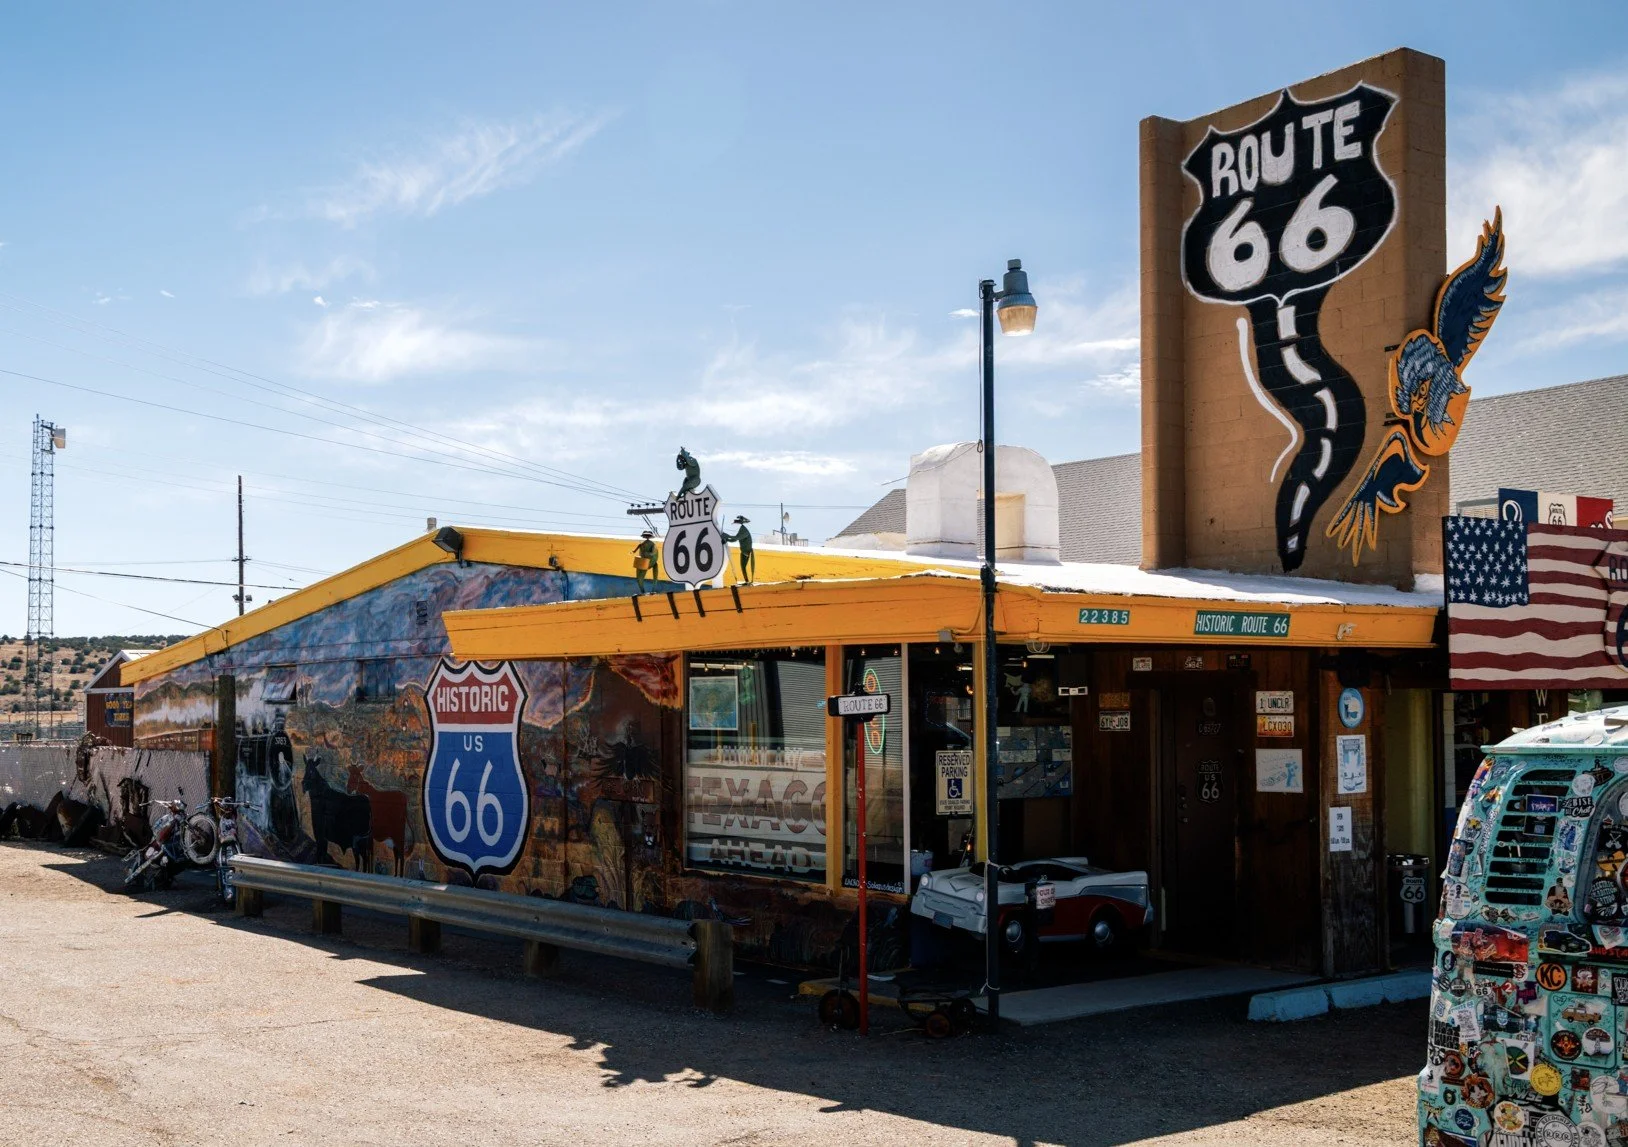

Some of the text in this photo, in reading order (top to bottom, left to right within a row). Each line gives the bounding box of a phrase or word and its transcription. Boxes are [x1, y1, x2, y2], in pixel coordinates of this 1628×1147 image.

[1211, 100, 1362, 197] ROUTE
[1206, 174, 1356, 292] 66
[670, 497, 710, 521] ROUTE
[673, 527, 714, 575] 66
[1080, 609, 1128, 624] 22385
[1195, 614, 1288, 634] HISTORIC ROUTE 66
[437, 684, 509, 713] HISTORIC
[843, 698, 883, 712] ROUTE 66
[463, 735, 483, 753] US
[939, 754, 970, 765] RESERVED
[942, 766, 968, 777] PARKING
[1204, 773, 1217, 781] US
[1201, 781, 1220, 799] 66
[445, 758, 504, 847] 66
[708, 838, 813, 872] AHEAD
[1404, 886, 1423, 899] 66
[1540, 964, 1562, 988] KC
[1475, 987, 1489, 996] 66
[1504, 982, 1513, 993] 2
